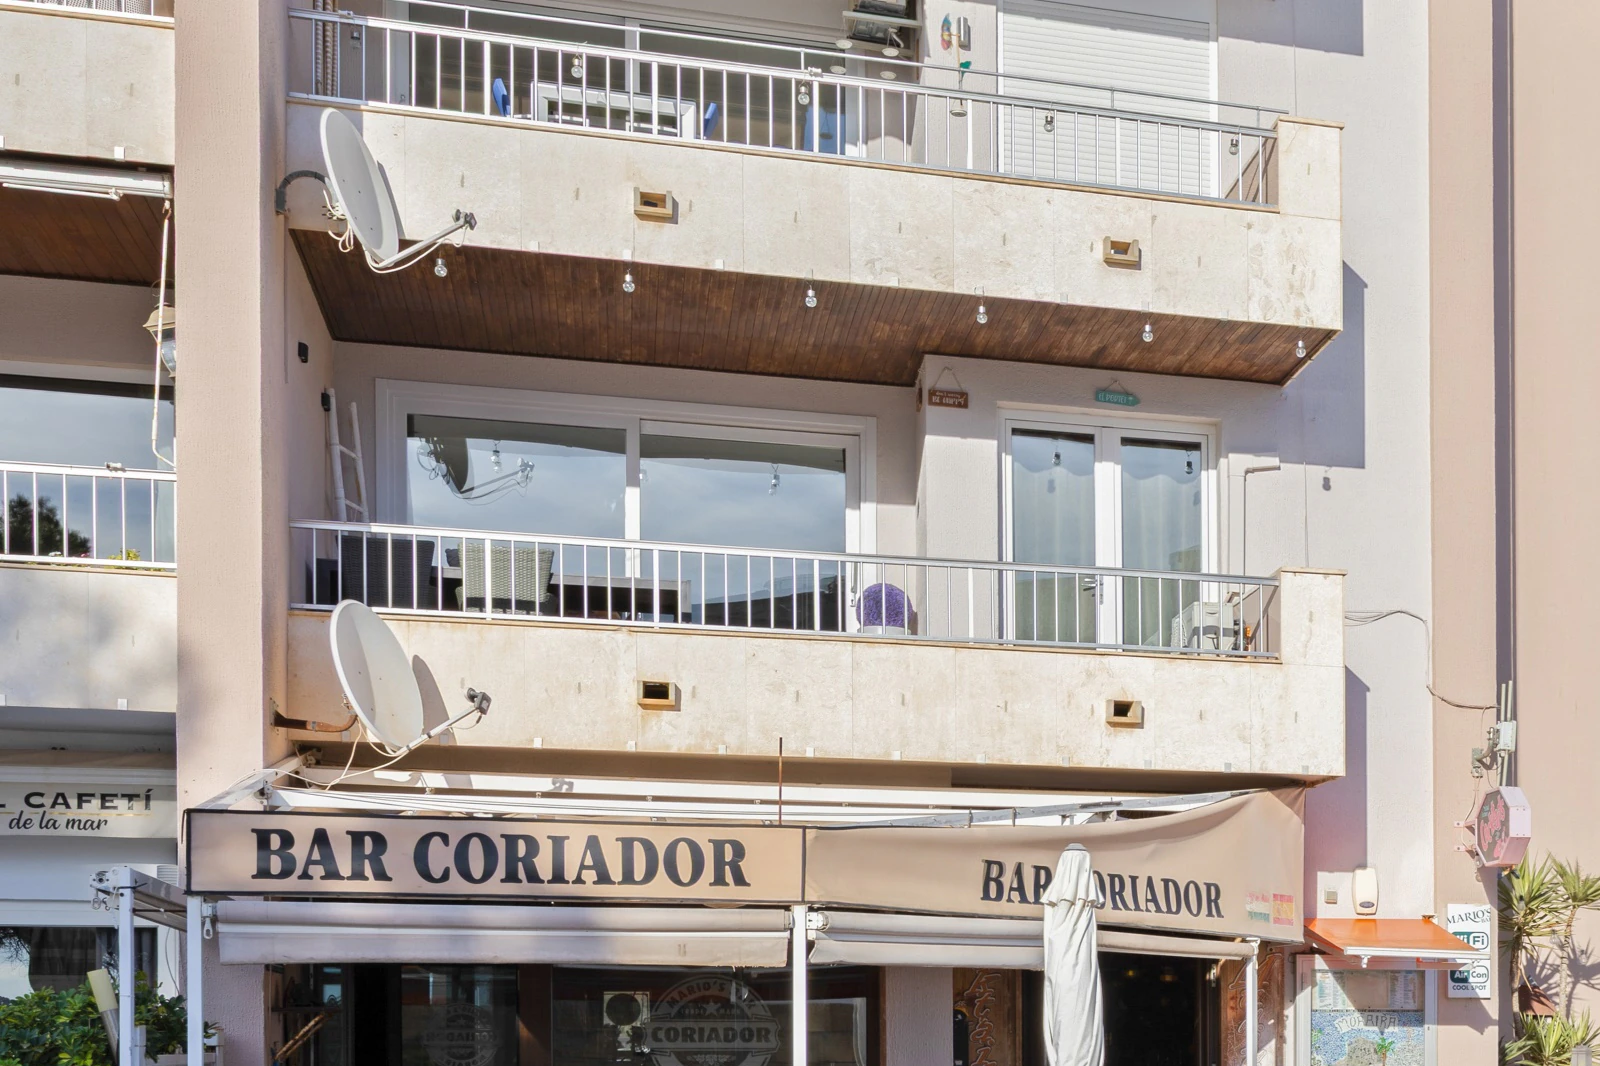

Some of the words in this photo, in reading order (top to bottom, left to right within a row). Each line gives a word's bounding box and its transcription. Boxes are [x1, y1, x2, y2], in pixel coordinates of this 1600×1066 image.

[24, 788, 154, 810] CAFETÍ
[8, 810, 34, 830] de
[39, 810, 61, 830] la
[65, 817, 108, 831] mar
[250, 827, 393, 882] BAR
[413, 831, 752, 887] CORIADOR
[1454, 971, 1468, 979] Air
[1471, 971, 1487, 979] Con
[651, 1026, 772, 1043] CORIADOR
